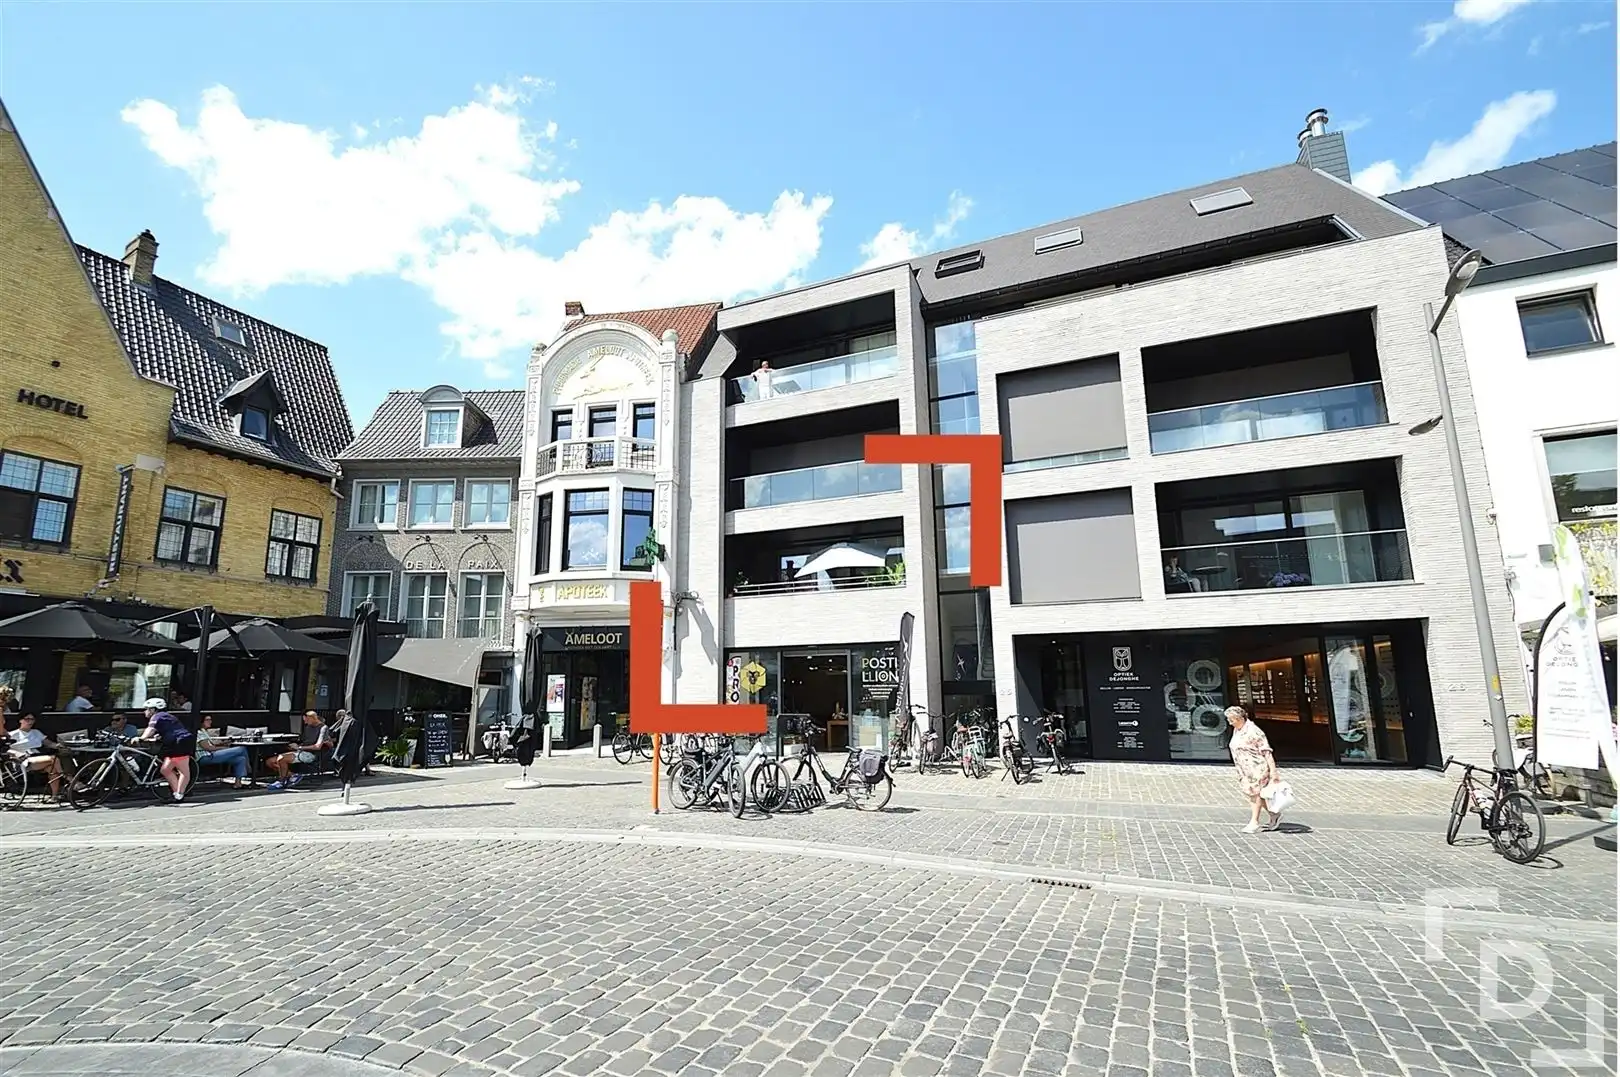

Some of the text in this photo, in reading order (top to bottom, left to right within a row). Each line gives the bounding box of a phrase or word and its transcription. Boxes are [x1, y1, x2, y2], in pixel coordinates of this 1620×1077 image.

[17, 388, 89, 420] HOTEL
[108, 475, 129, 572] RESTAURANT
[405, 560, 424, 570] DE
[430, 560, 446, 570] LA
[467, 559, 499, 570] PAIX
[564, 632, 623, 645] AMELOOT
[861, 656, 898, 669] POSTI
